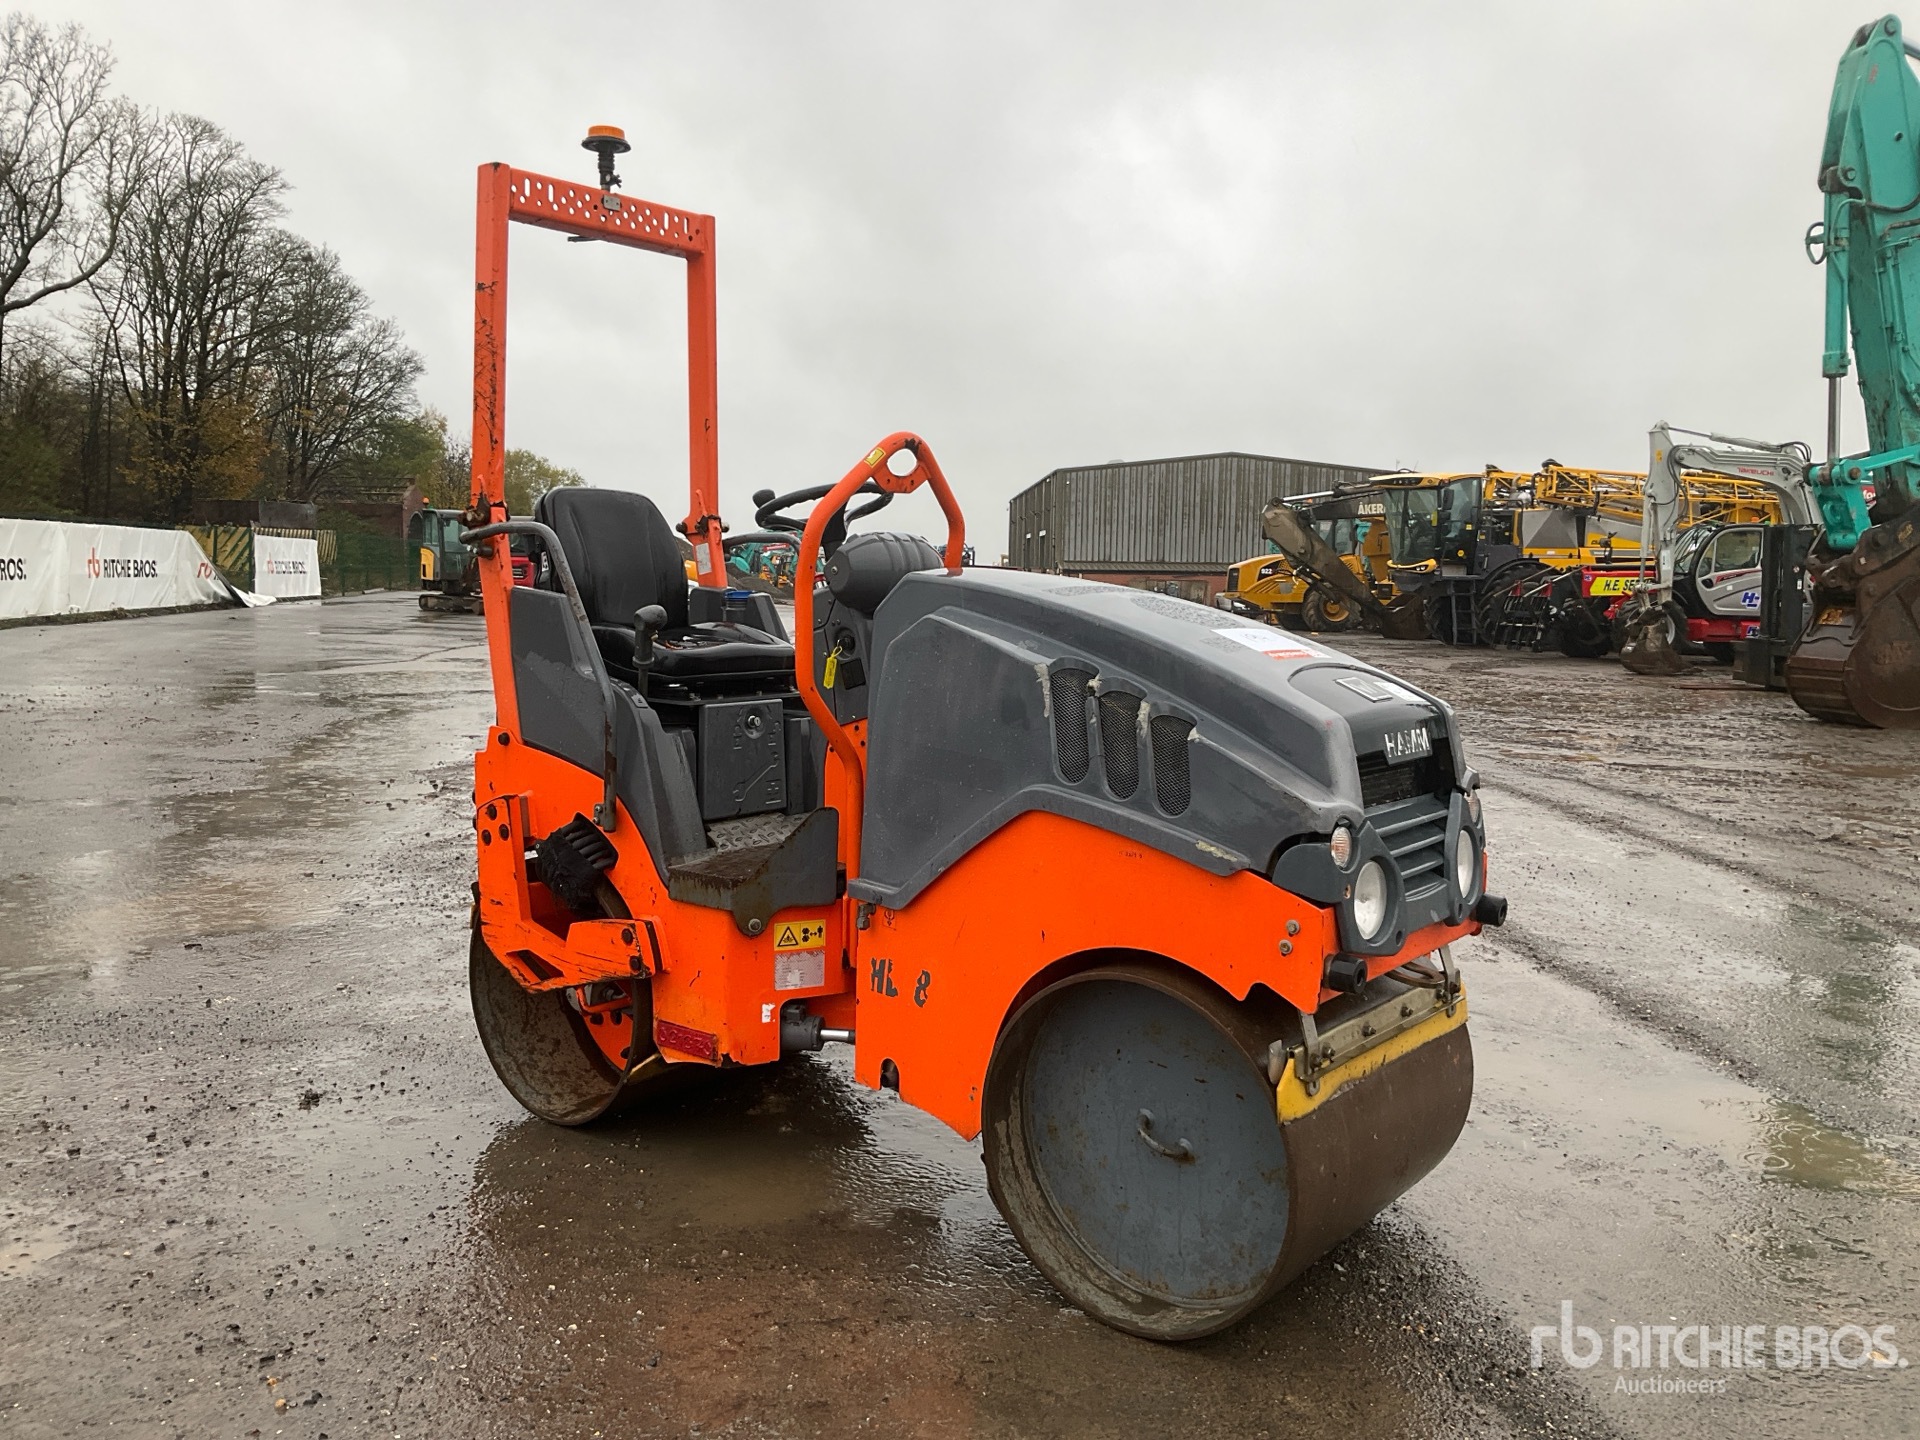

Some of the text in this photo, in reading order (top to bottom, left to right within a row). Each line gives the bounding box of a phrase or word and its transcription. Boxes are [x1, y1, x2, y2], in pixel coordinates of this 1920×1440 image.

[1357, 501, 1386, 515] ÅKER
[103, 559, 131, 578] RITCHIE
[1384, 727, 1430, 757] HAMM
